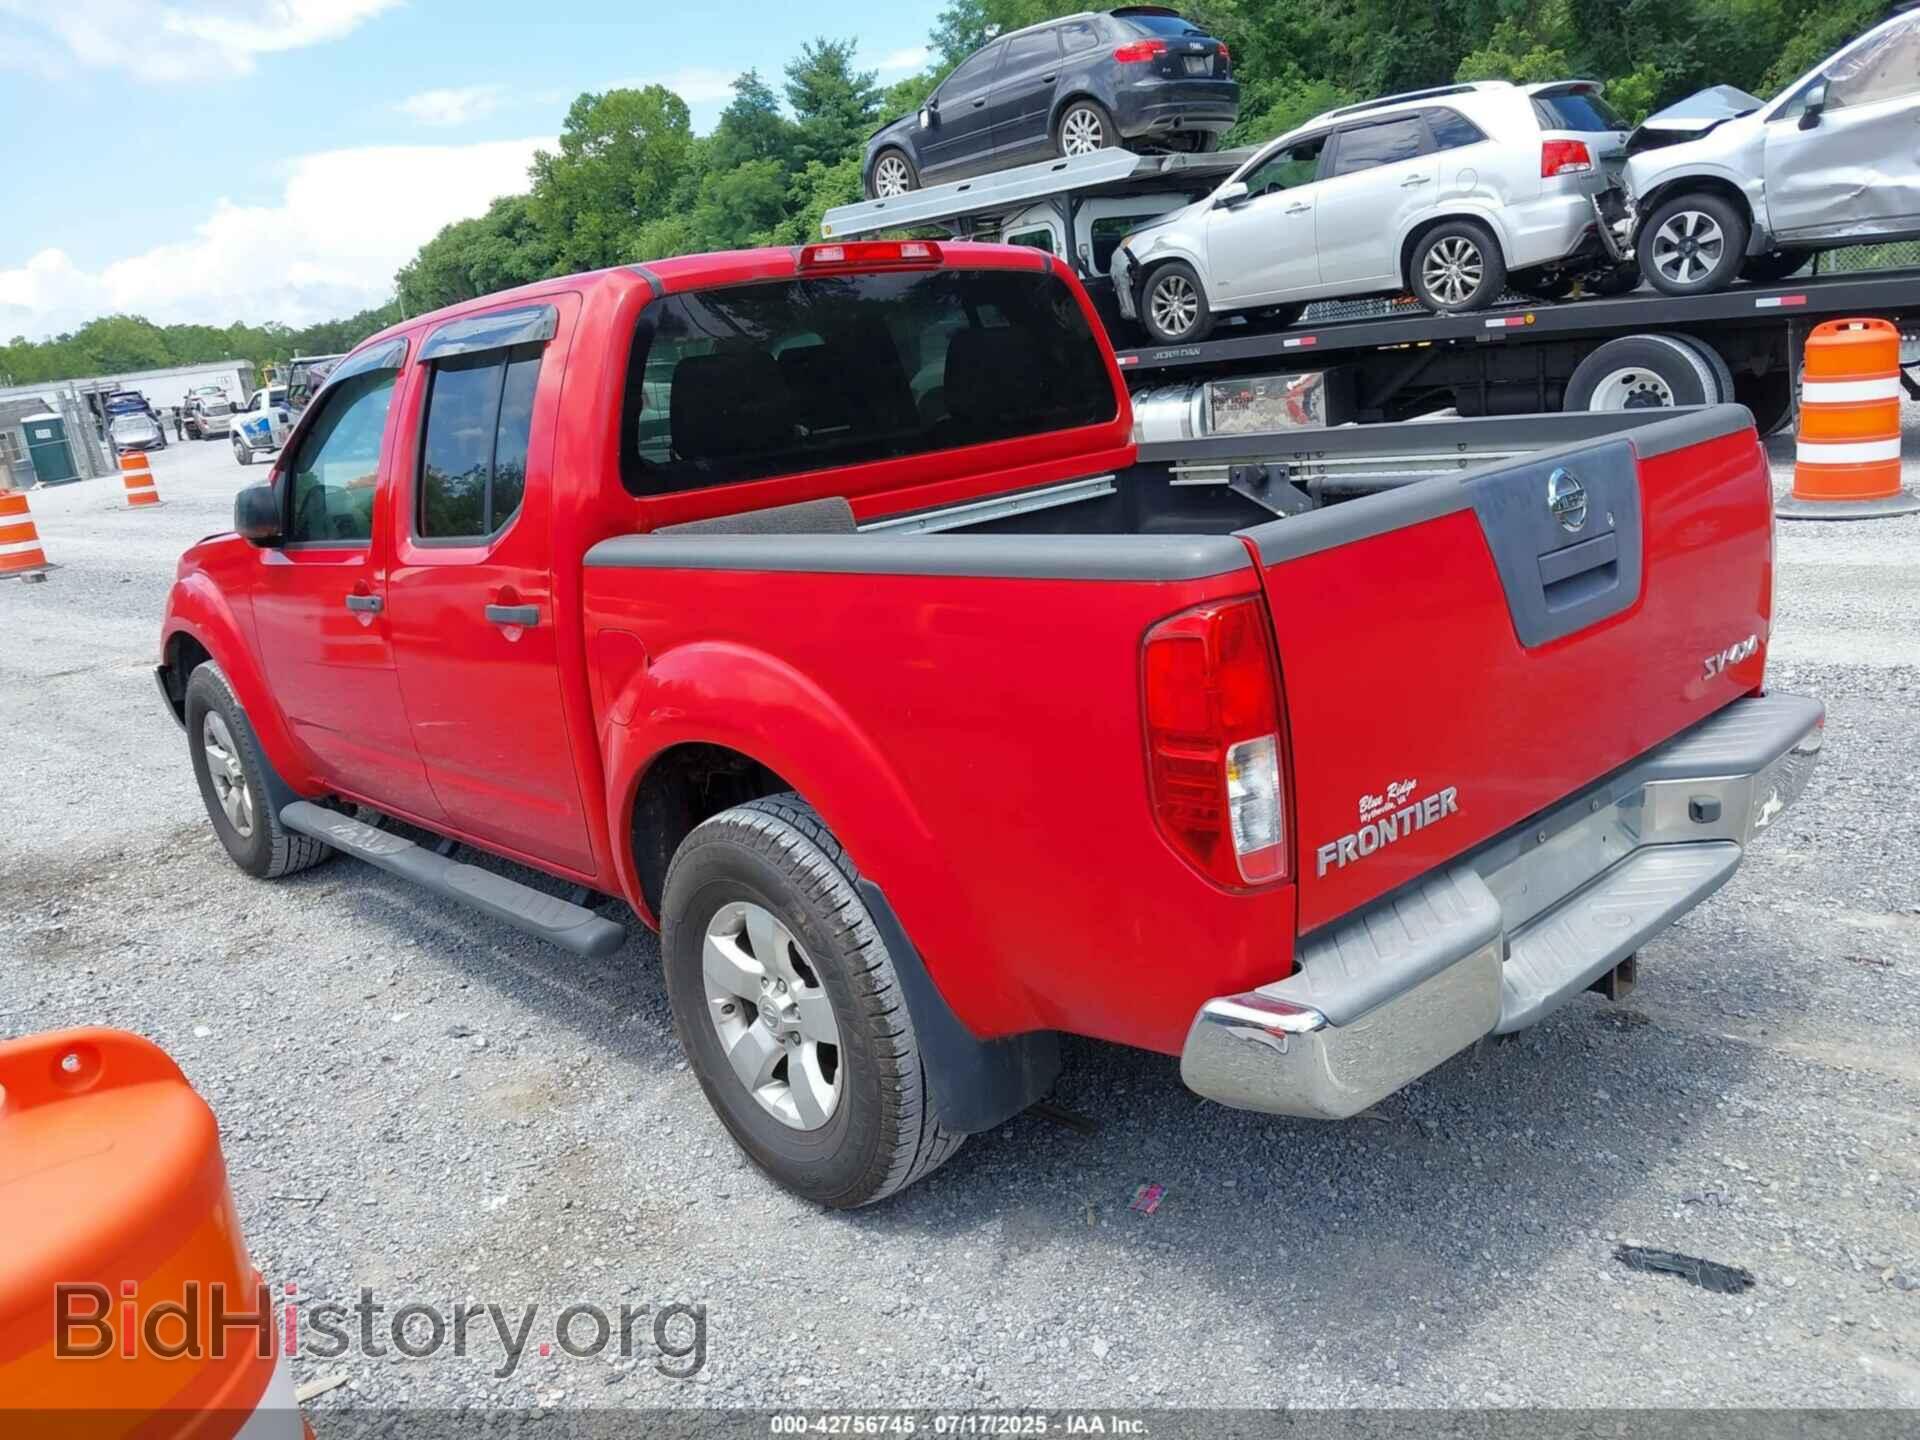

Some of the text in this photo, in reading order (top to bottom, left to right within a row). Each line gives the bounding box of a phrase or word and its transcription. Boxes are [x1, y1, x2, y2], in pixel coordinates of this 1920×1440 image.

[1359, 778, 1417, 814] Blue Ridge
[1316, 786, 1459, 879] FRONTIER
